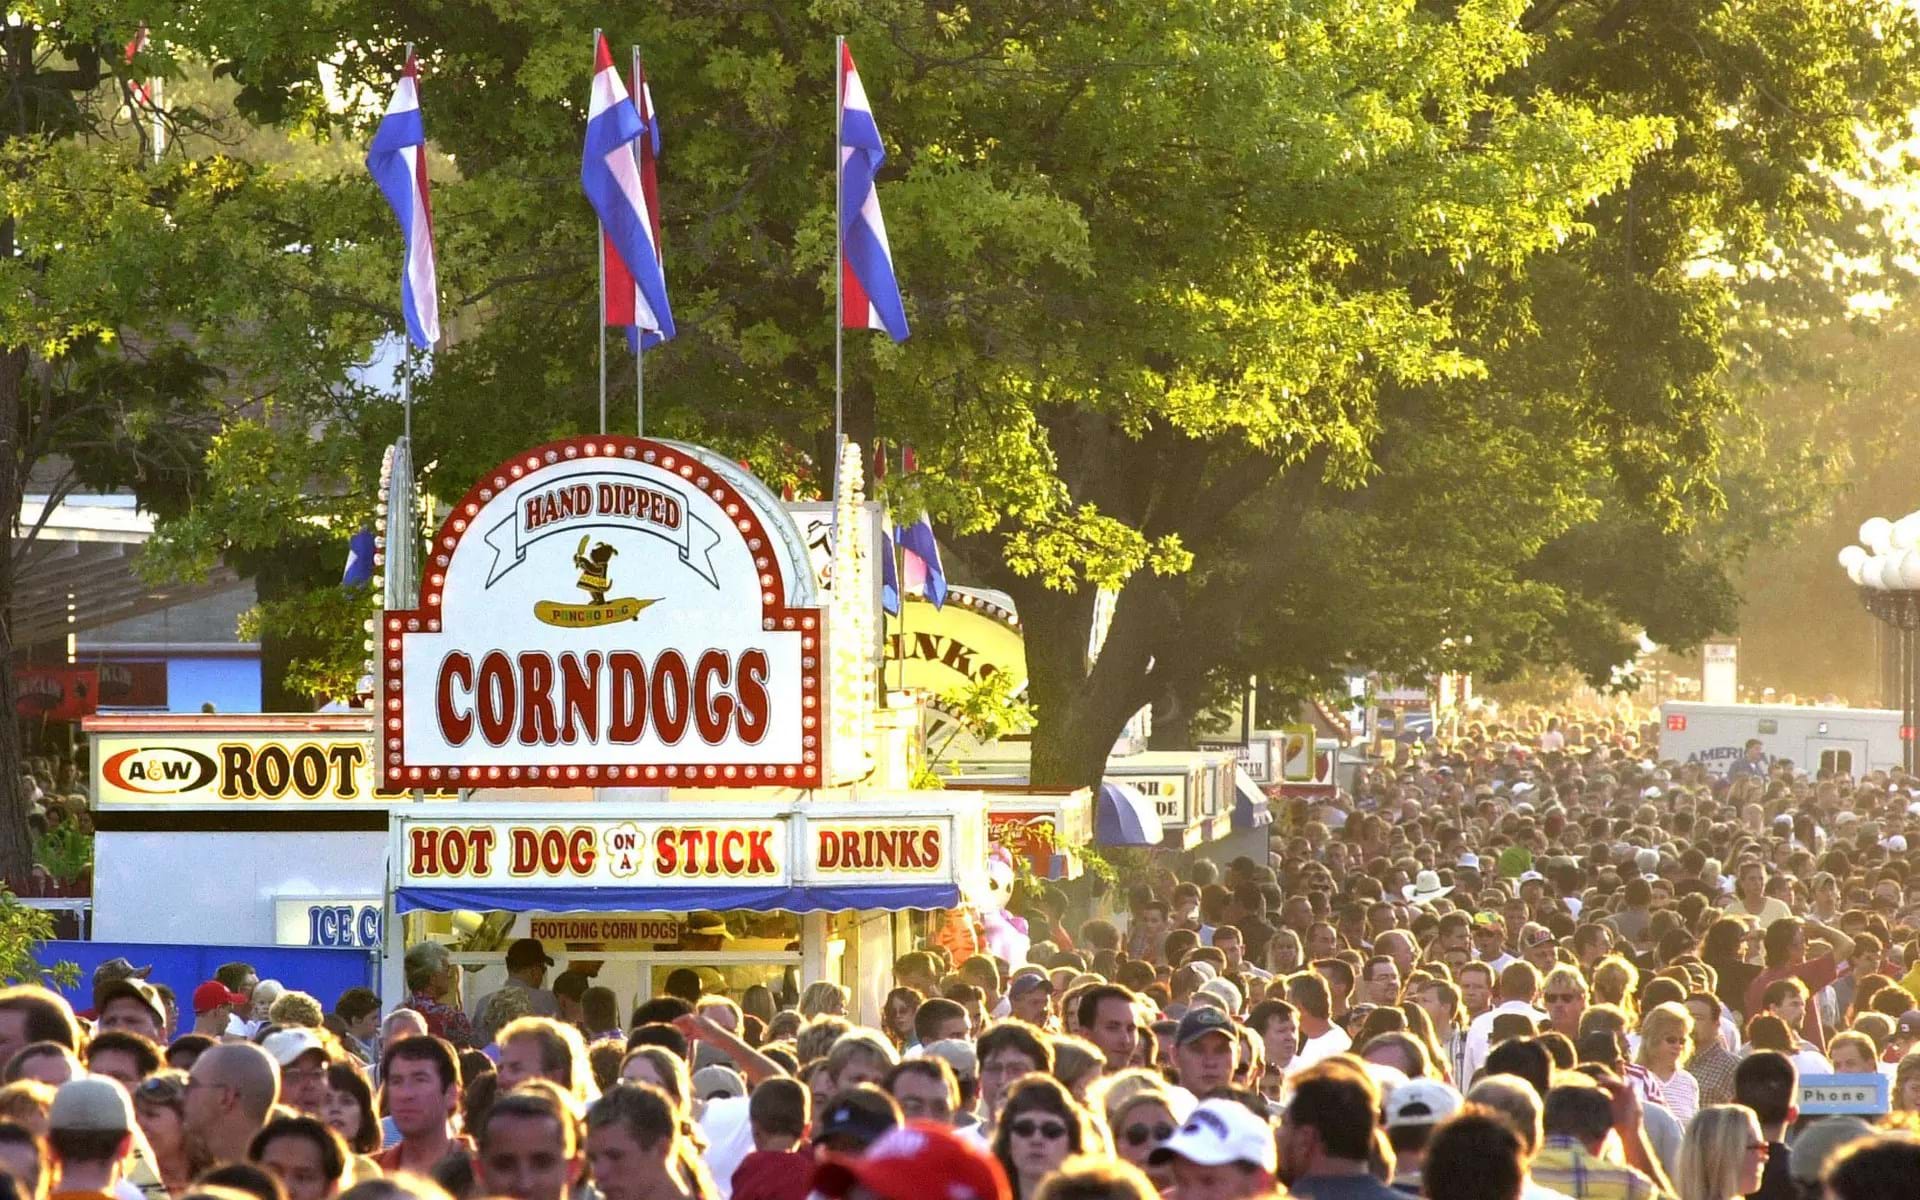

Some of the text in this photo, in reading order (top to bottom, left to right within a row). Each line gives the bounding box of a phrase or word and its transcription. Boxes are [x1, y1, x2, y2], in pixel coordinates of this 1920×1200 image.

[525, 484, 682, 531] HAND DIPPED
[552, 605, 629, 622] PANCHO DOG
[128, 761, 193, 781] A&W
[218, 743, 365, 799] ROOT
[409, 820, 778, 878] HOT DOG ON A STICK
[817, 824, 943, 873] DRINKS
[308, 905, 384, 947] ICE C
[531, 921, 678, 940] FOOTLONG CORN DOGS
[1803, 1090, 1866, 1102] Phone
